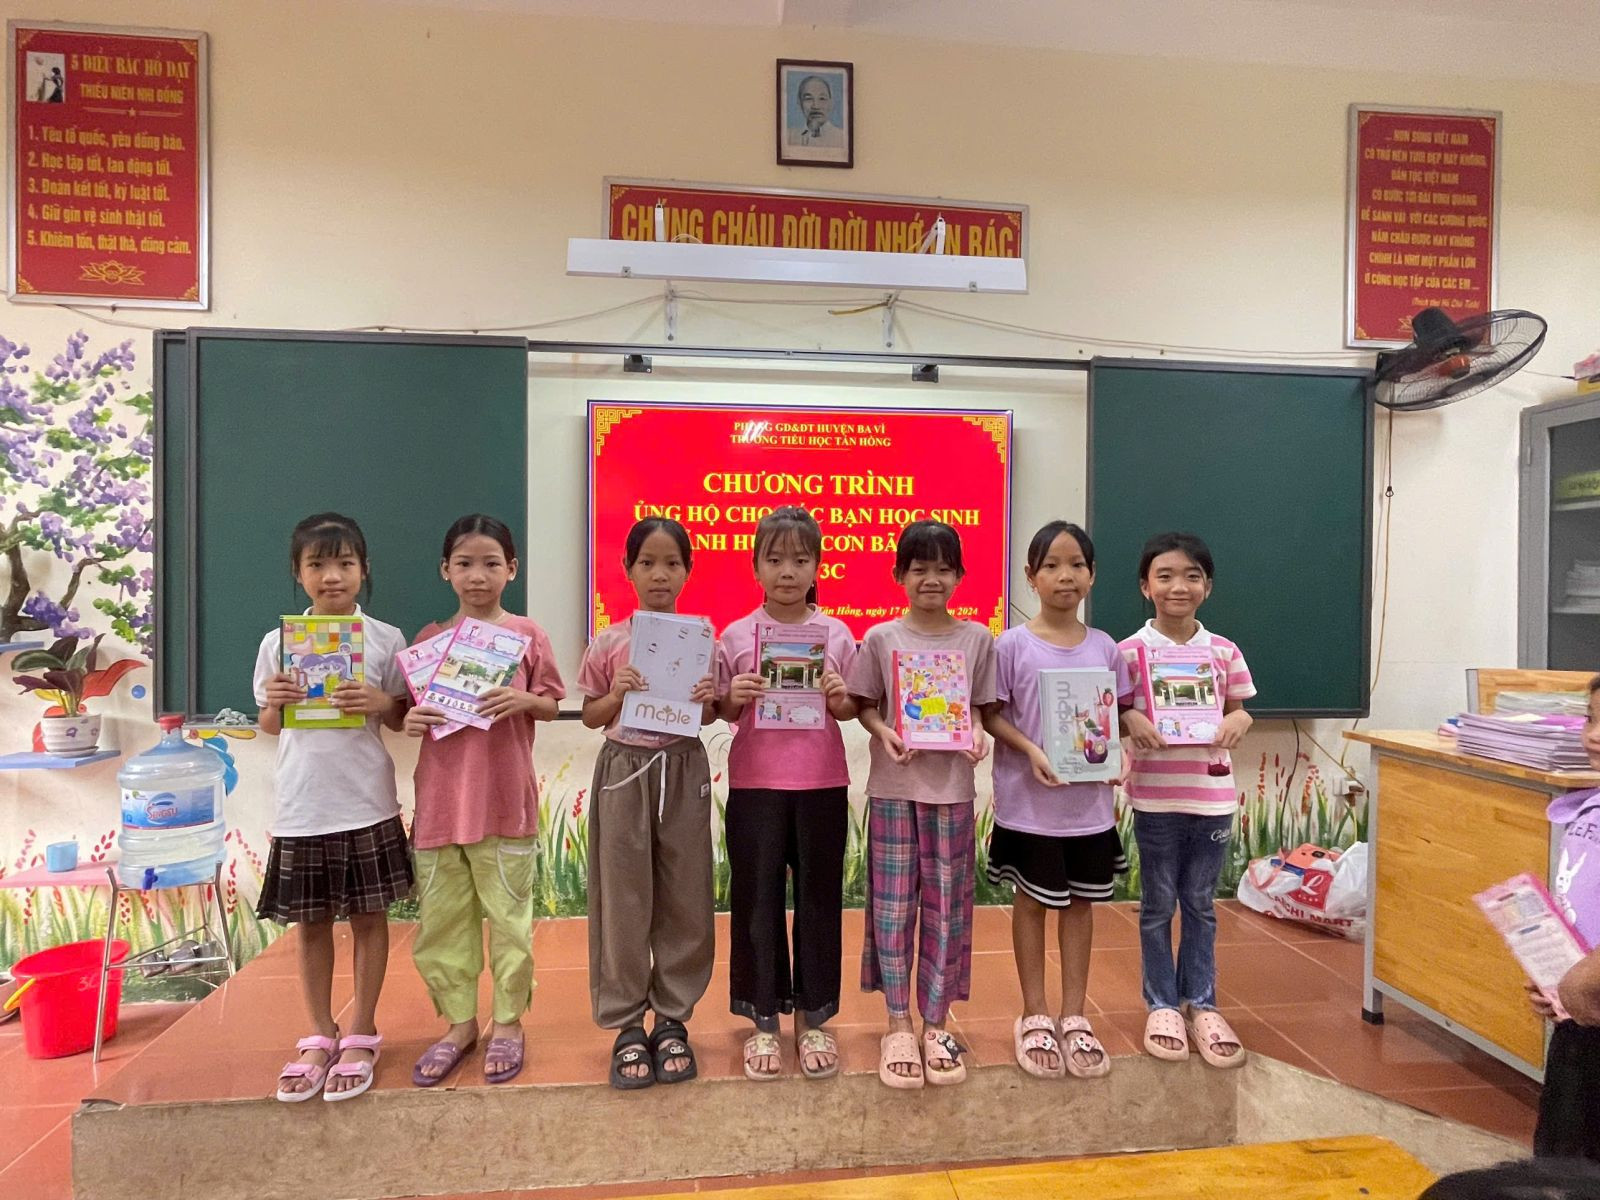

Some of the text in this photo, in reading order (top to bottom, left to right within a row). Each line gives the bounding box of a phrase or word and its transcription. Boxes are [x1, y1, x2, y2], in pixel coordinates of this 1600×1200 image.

[71, 54, 79, 70] 5
[116, 52, 141, 75] BÁC
[166, 61, 191, 83] DẠY
[42, 126, 63, 143] Yêu
[42, 152, 63, 173] Học
[66, 154, 83, 174] tập
[107, 157, 124, 173] lao
[127, 157, 153, 178] động
[74, 179, 91, 197] kết
[130, 184, 150, 204] luật
[84, 207, 97, 227] vệ
[100, 209, 122, 225] sinh
[125, 209, 146, 229] thật
[40, 230, 73, 248] Khiêm
[98, 234, 117, 254] thật
[141, 236, 165, 255] dũng
[712, 204, 775, 247] CHÁU
[782, 207, 821, 249] ĐỜI
[829, 210, 868, 252] ĐỜI
[875, 212, 925, 254] NHỚ
[969, 218, 1014, 258] BÁC
[817, 423, 854, 435] HUYỆN
[857, 424, 872, 434] BA
[808, 436, 832, 447] HỌC
[703, 470, 914, 496] CHƯƠNG TRÌNH
[688, 503, 720, 526] HỘ
[725, 505, 774, 523] CHO
[830, 507, 872, 528] BẠN
[879, 508, 925, 528] HỌC
[930, 509, 980, 526] SINH
[821, 534, 865, 552] CƠN
[871, 533, 898, 552] BÃ
[819, 563, 846, 579] 3C
[866, 606, 887, 618] ngày
[889, 606, 900, 615] 17
[957, 607, 978, 616] 2024
